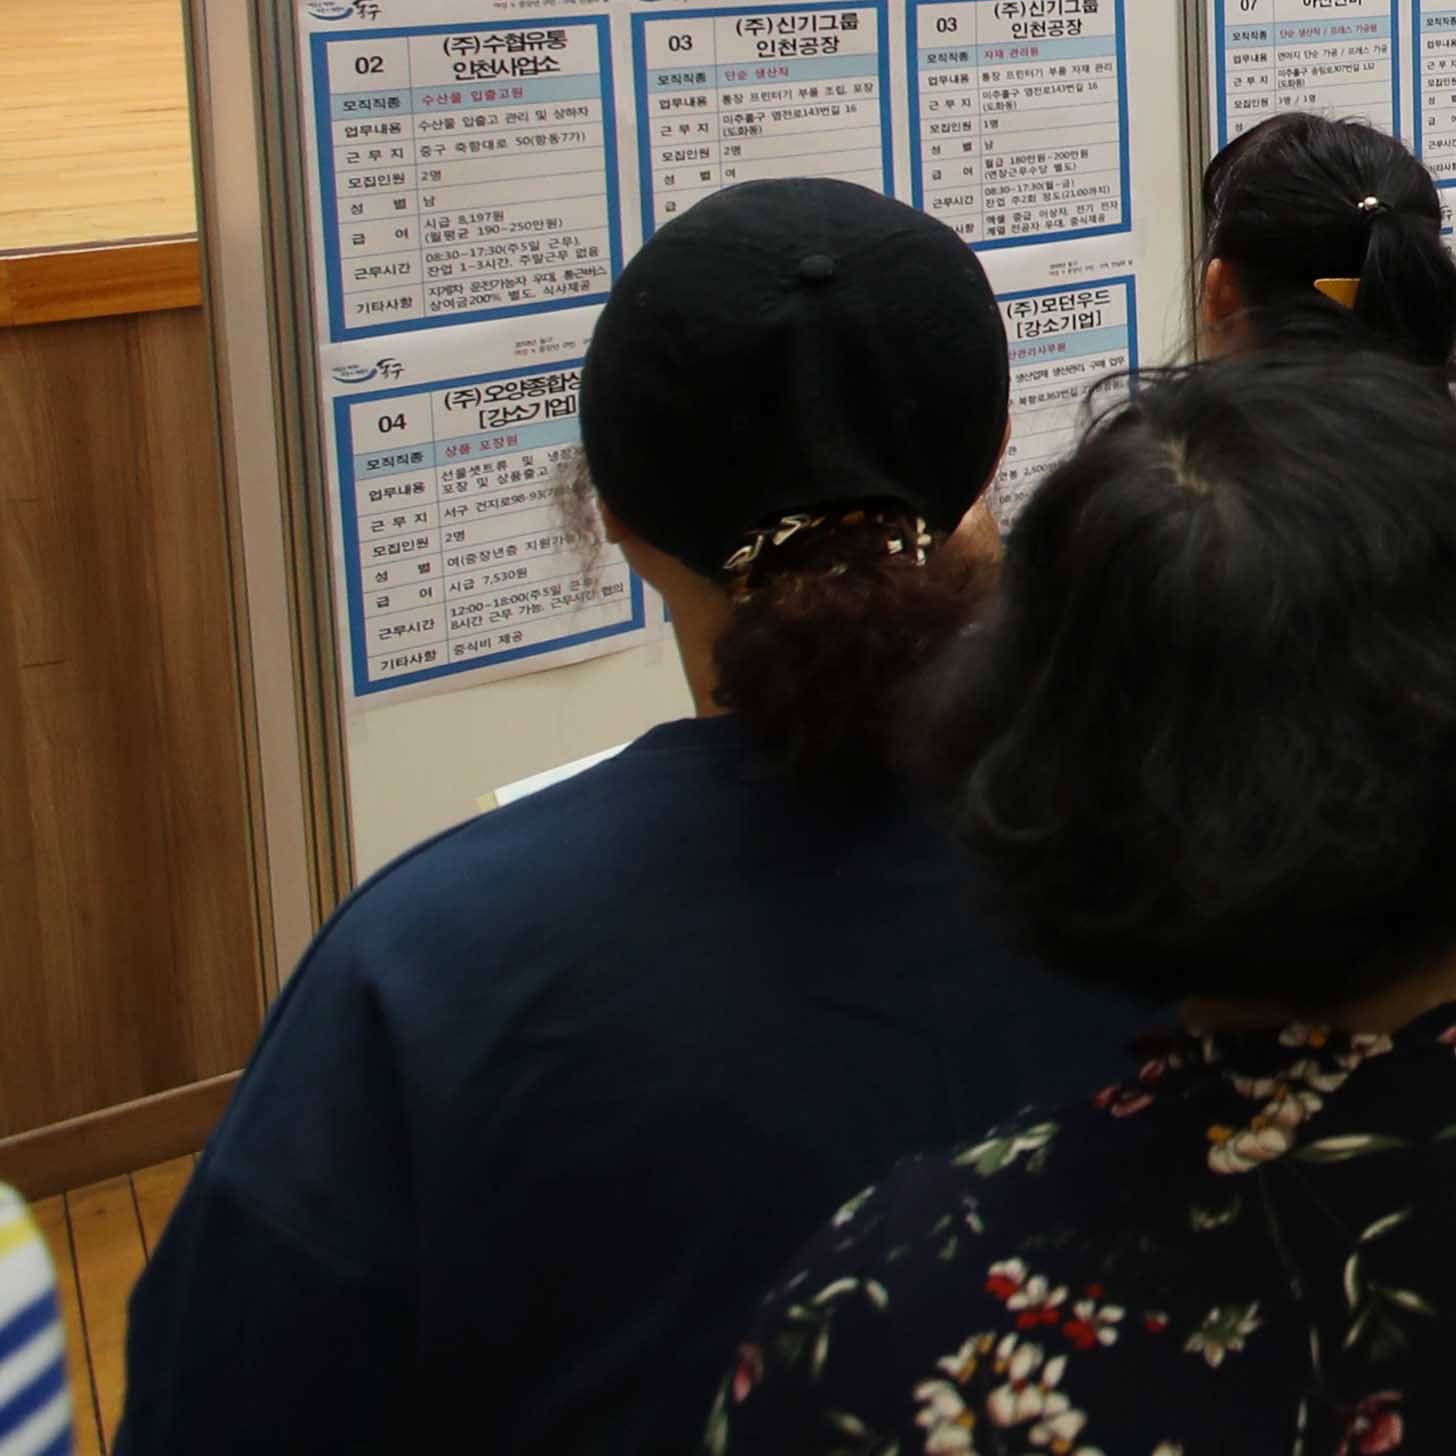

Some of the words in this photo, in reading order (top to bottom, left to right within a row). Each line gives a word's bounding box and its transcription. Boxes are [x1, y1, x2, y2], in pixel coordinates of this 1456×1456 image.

[736, 12, 858, 36] (주)신기그룹
[937, 17, 957, 32] 03
[1012, 19, 1082, 40] 인천공장
[443, 29, 568, 57] (주)수협유통
[669, 35, 692, 52] 03
[756, 36, 839, 58] 인천공장
[355, 56, 384, 74] 02
[453, 57, 560, 81] 인천사업소
[345, 123, 401, 138] 업무내용
[348, 173, 405, 188] 모집인원
[425, 217, 450, 229] 시급
[354, 263, 410, 280] 근무시간
[357, 297, 413, 314] 기타사항
[1006, 289, 1111, 318] (주)모던우드
[1016, 310, 1102, 339] [강소기업]
[479, 395, 576, 430] [강소기업]
[379, 413, 407, 433] 04
[368, 482, 425, 502] 업무내용
[373, 538, 430, 557] 모집인원
[450, 579, 475, 592] 시급
[379, 620, 435, 640] 근무시간
[498, 631, 523, 644] 제공
[381, 651, 437, 670] 기타사항
